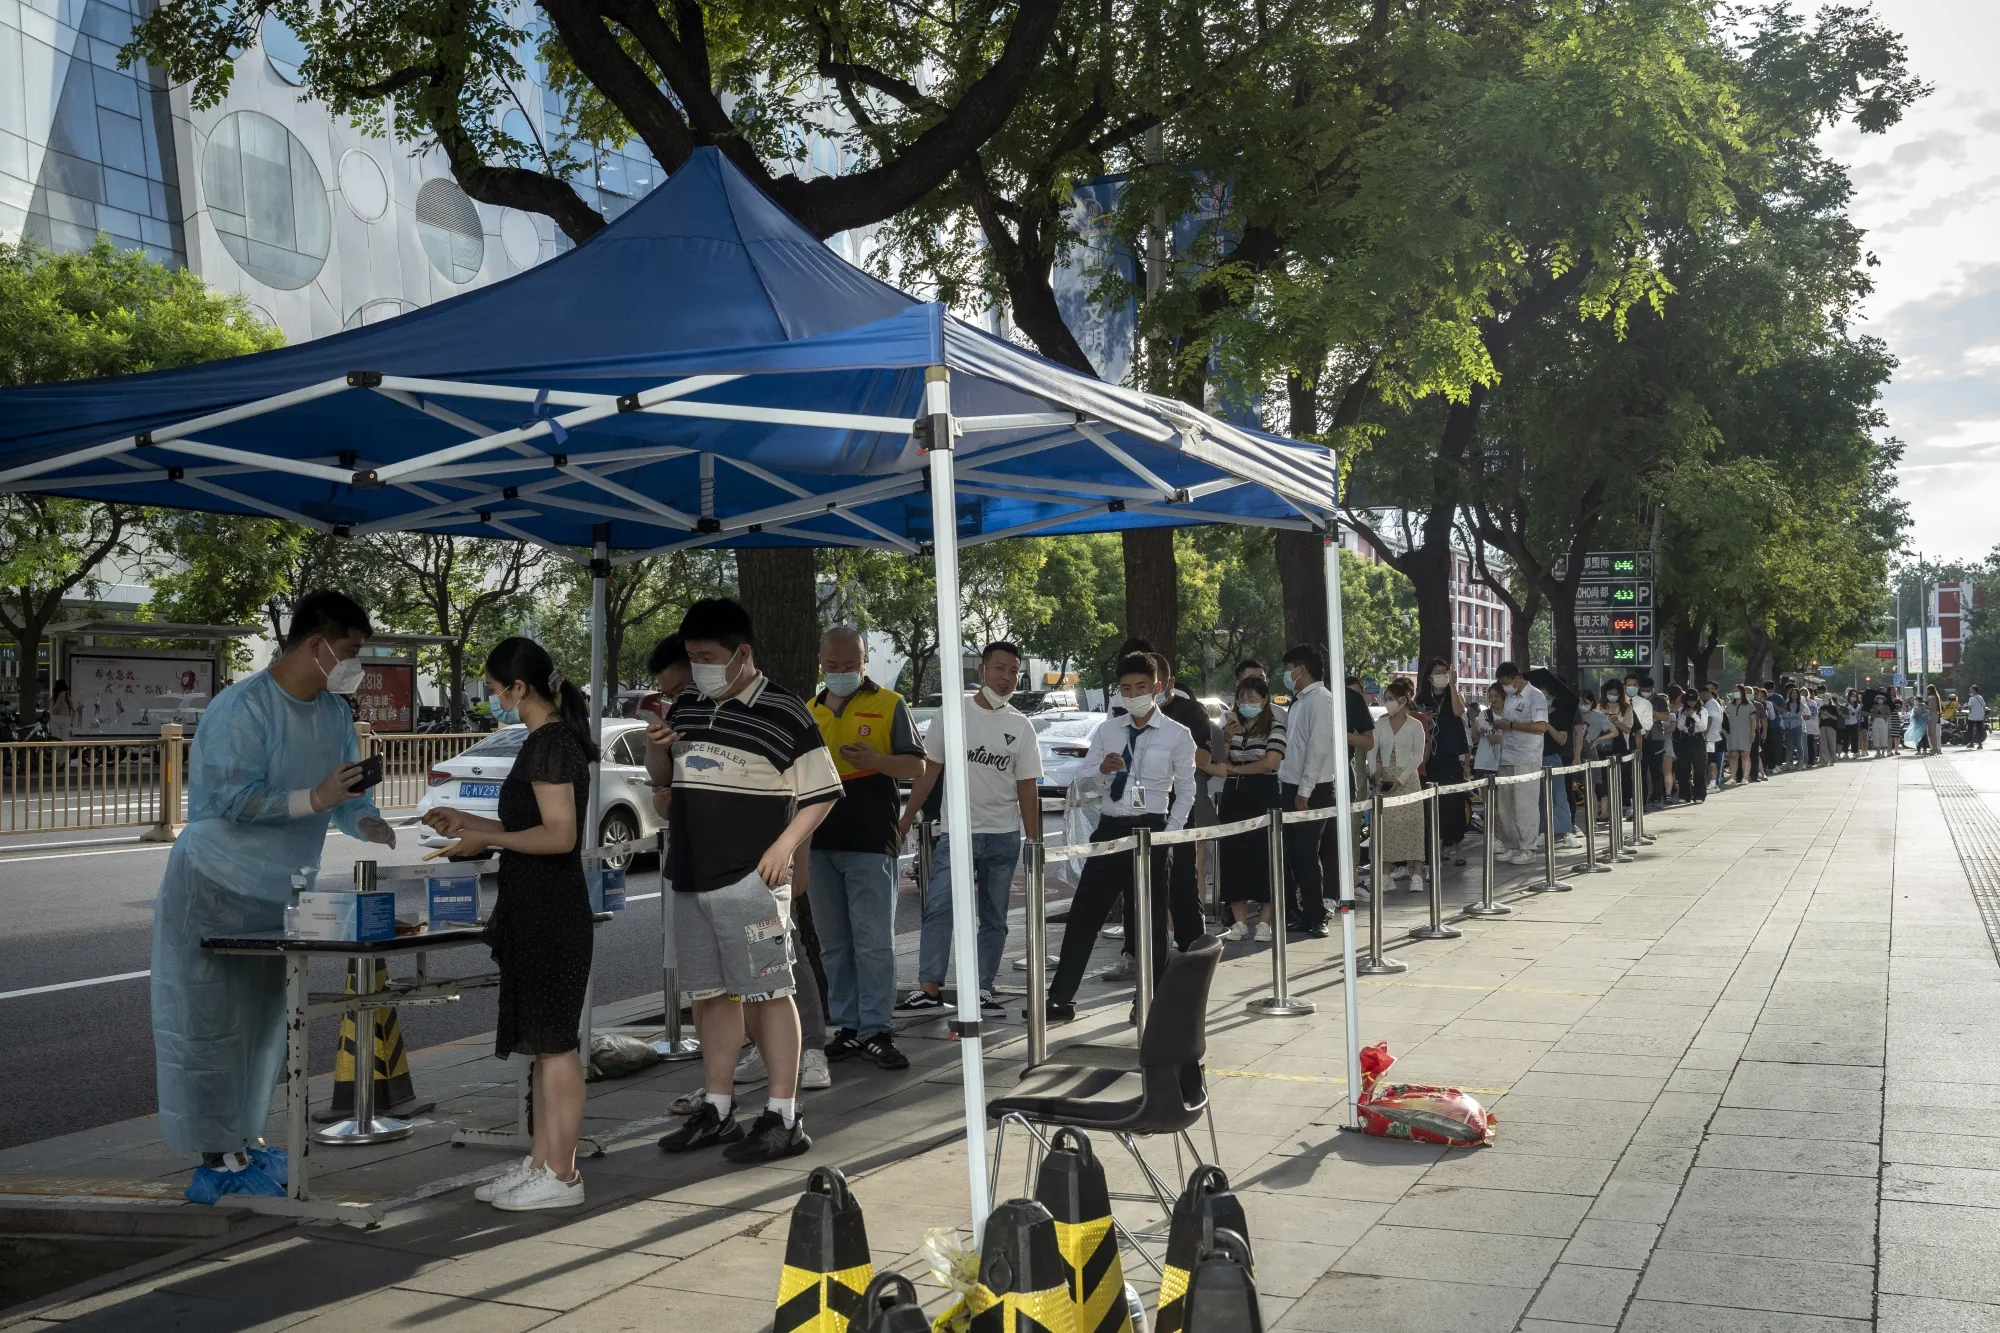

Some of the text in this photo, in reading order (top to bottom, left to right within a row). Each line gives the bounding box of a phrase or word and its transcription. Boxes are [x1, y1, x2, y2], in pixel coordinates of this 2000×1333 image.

[1639, 586, 1650, 602] P
[1574, 614, 1610, 626] 世贸天阶
[1639, 616, 1650, 632] P
[1639, 645, 1650, 661] P
[366, 674, 382, 690] 818
[706, 746, 746, 767] HEALER
